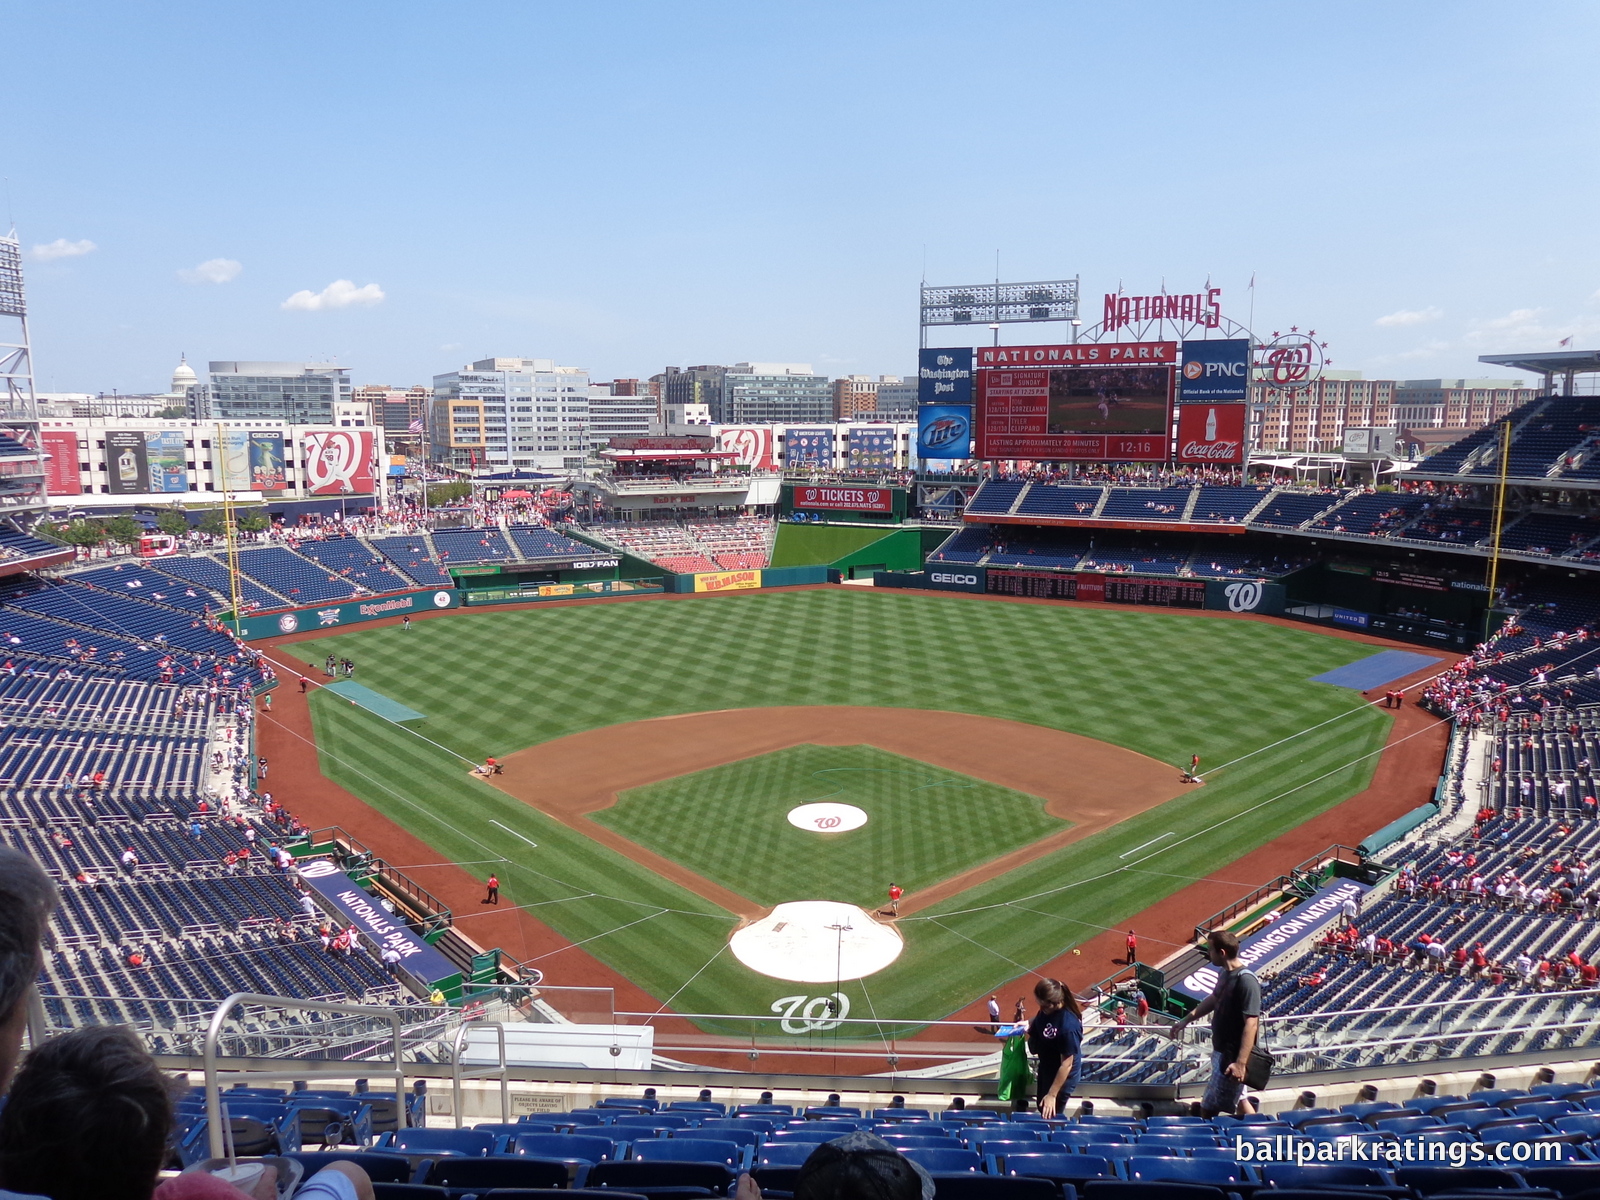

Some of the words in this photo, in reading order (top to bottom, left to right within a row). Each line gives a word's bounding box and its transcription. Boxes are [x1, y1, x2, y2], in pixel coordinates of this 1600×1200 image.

[1104, 288, 1221, 332] NATIONALS
[936, 355, 953, 366] The
[984, 348, 1099, 362] NATIONALS
[1110, 346, 1165, 359] PARK
[920, 367, 970, 381] Washington
[1205, 363, 1246, 377] PNC
[934, 382, 955, 394] Post
[1014, 439, 1062, 447] APPROXIMATELY
[1072, 439, 1100, 447] MINUTES
[1119, 442, 1150, 453] 12:16
[653, 496, 668, 504] RED
[819, 489, 864, 502] TICKETS
[597, 560, 618, 568] FAN
[931, 573, 977, 585] GEICO
[1224, 582, 1263, 613] W
[359, 597, 412, 616] ExxonMobil
[1334, 613, 1358, 622] UNITED
[814, 816, 842, 829] W
[336, 889, 393, 936] NATIONALS
[383, 929, 423, 958] PARK
[1238, 919, 1299, 967] ASHINGTON
[1300, 883, 1361, 923] NATIONALS
[770, 992, 850, 1035] W
